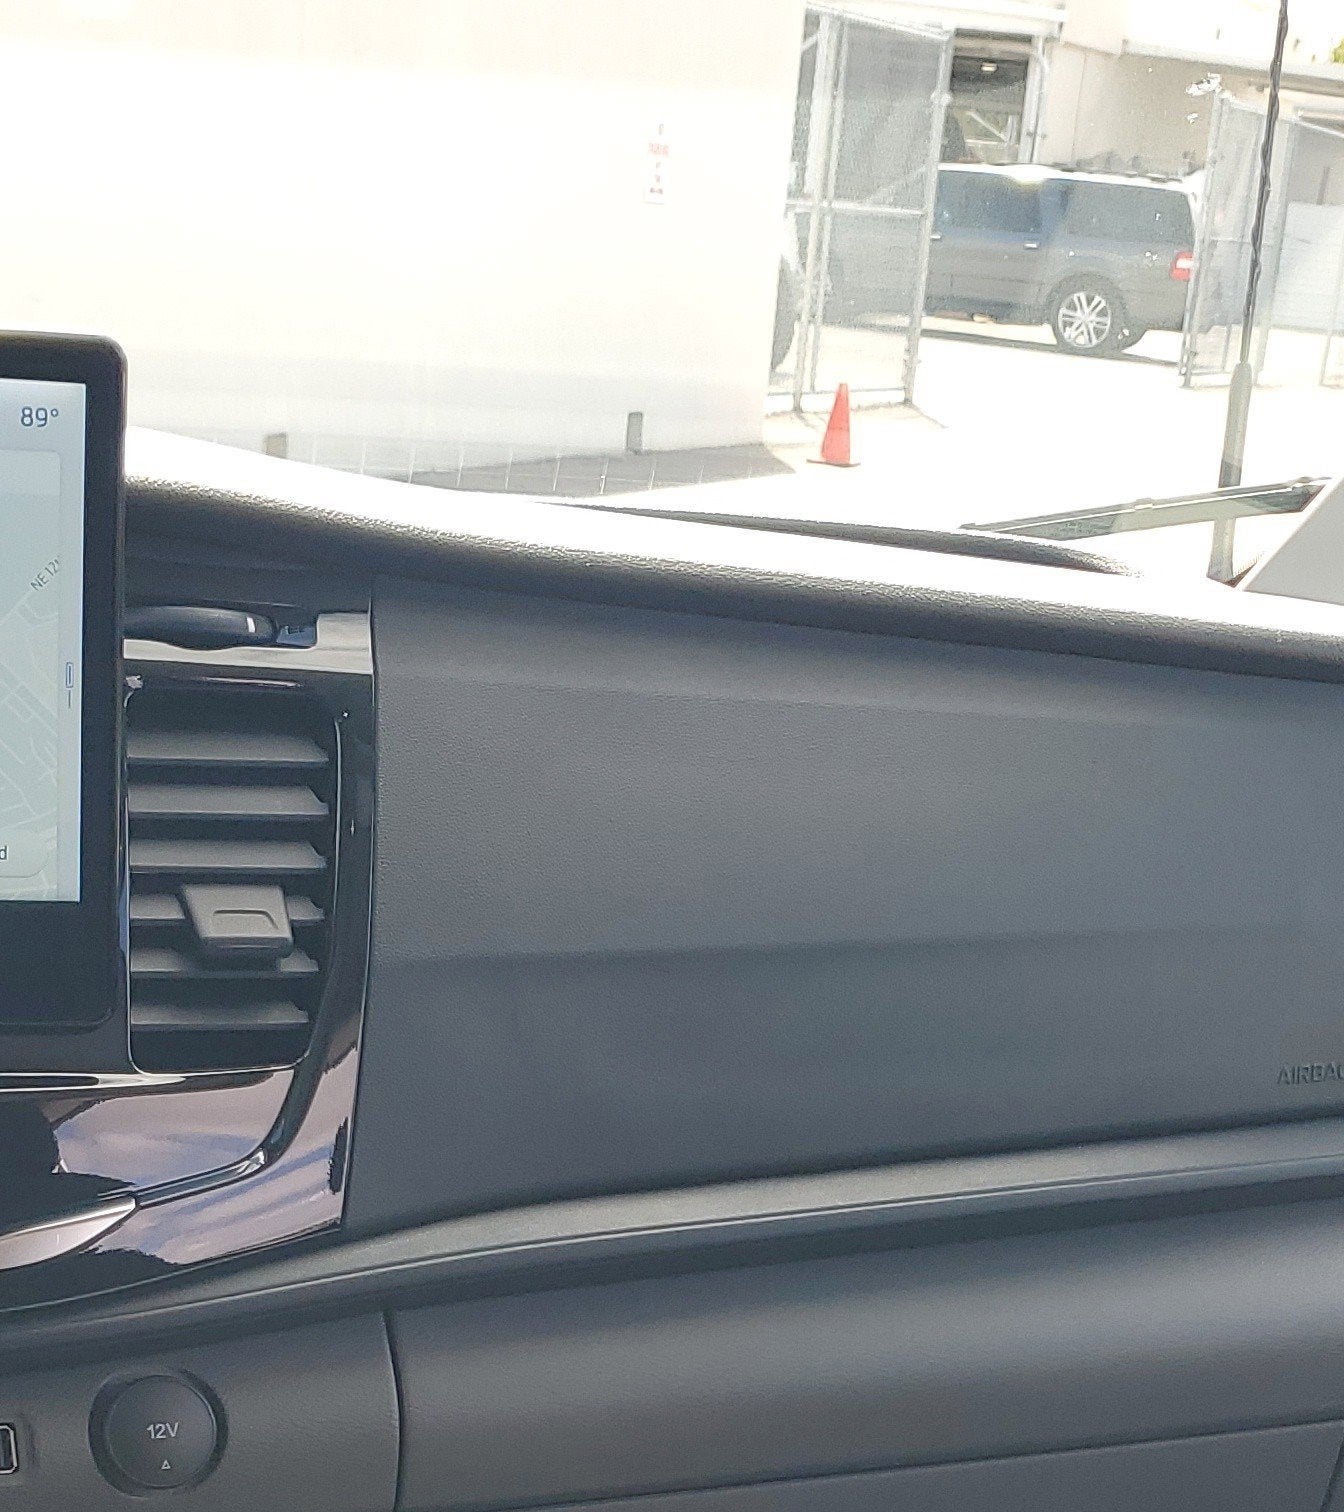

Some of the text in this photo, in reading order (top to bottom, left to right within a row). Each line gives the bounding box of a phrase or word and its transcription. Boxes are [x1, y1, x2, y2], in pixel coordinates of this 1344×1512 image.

[30, 558, 60, 591] NE 12
[145, 1421, 180, 1440] 12V
